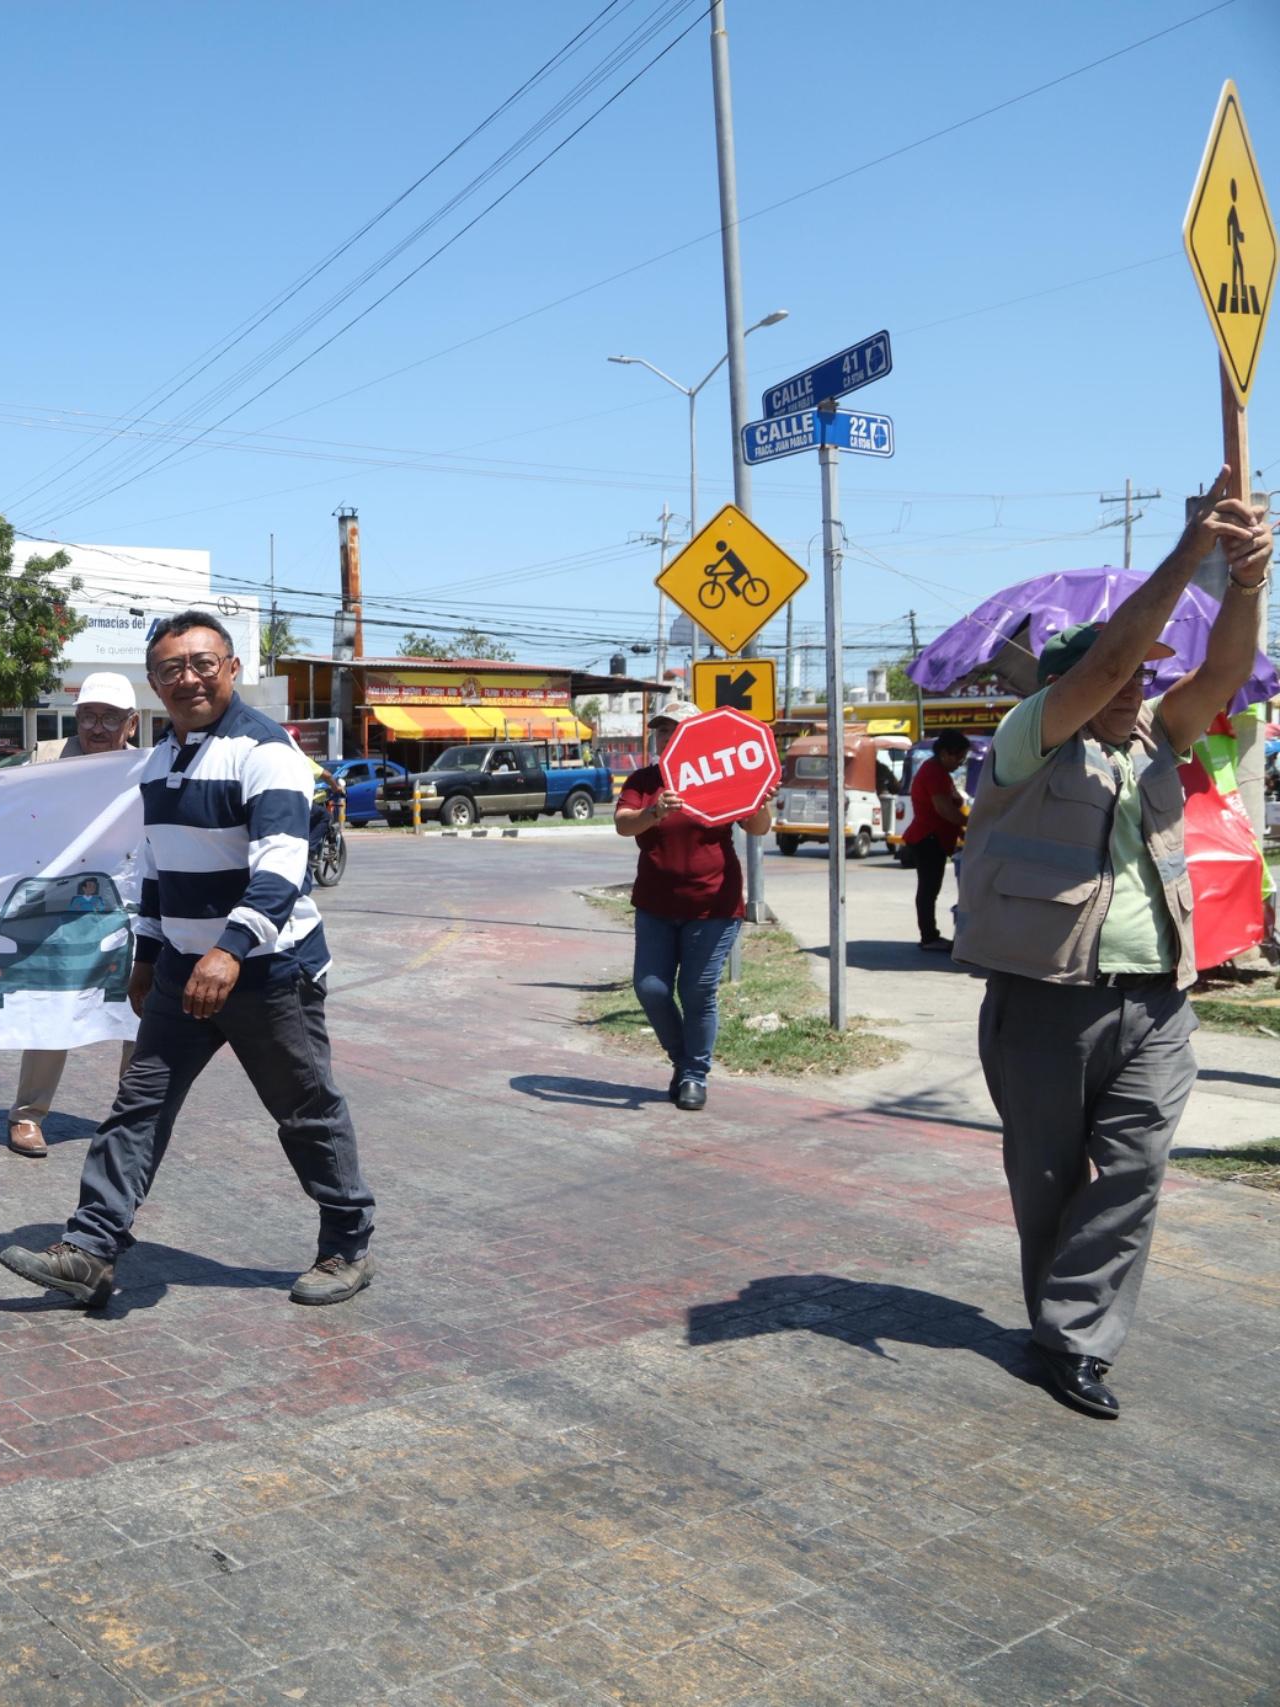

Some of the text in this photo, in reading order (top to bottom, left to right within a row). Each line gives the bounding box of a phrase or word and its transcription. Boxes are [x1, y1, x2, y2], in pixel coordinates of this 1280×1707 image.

[772, 351, 859, 410] CALLE 41
[755, 413, 868, 445] CALLE 22
[87, 616, 130, 629] armacias
[132, 617, 146, 630] del
[108, 645, 147, 658] queremo
[678, 740, 765, 792] ALTO
